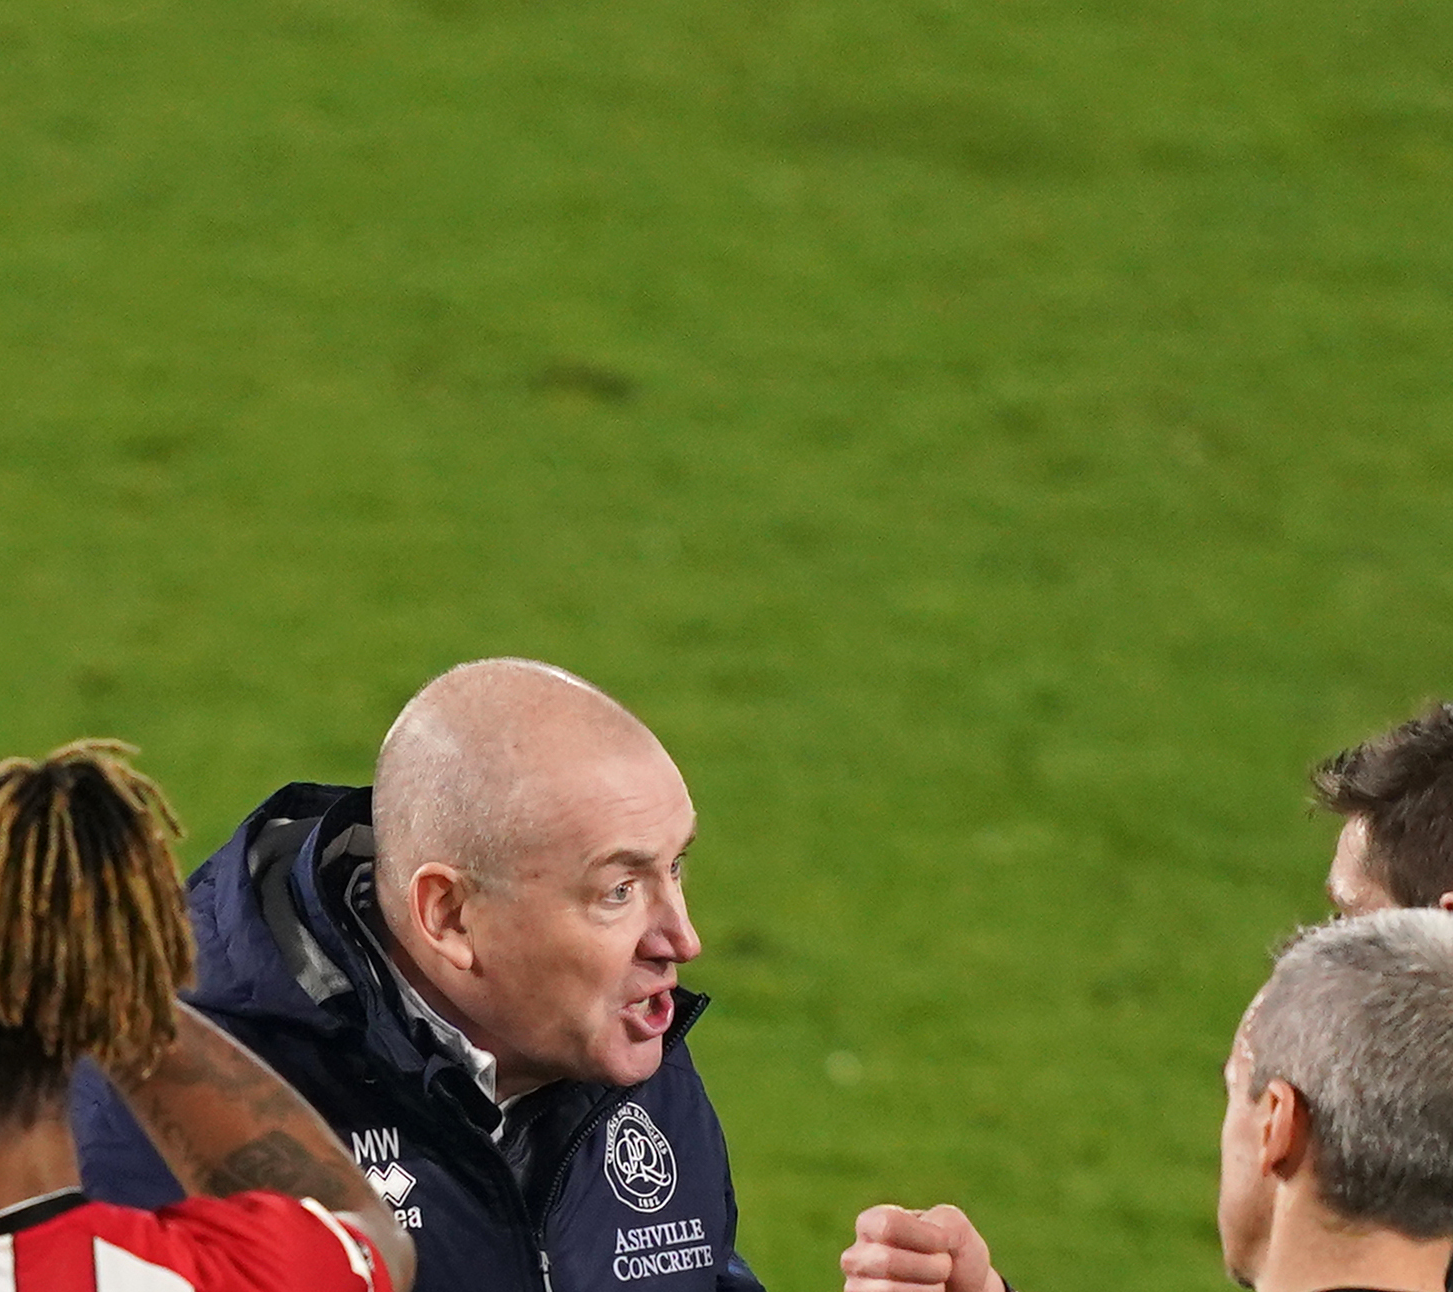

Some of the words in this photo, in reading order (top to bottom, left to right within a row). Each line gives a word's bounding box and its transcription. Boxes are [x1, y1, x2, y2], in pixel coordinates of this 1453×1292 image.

[352, 1127, 400, 1165] MW
[614, 1219, 705, 1254] ASHVILLE
[613, 1245, 714, 1282] CONCRETE
